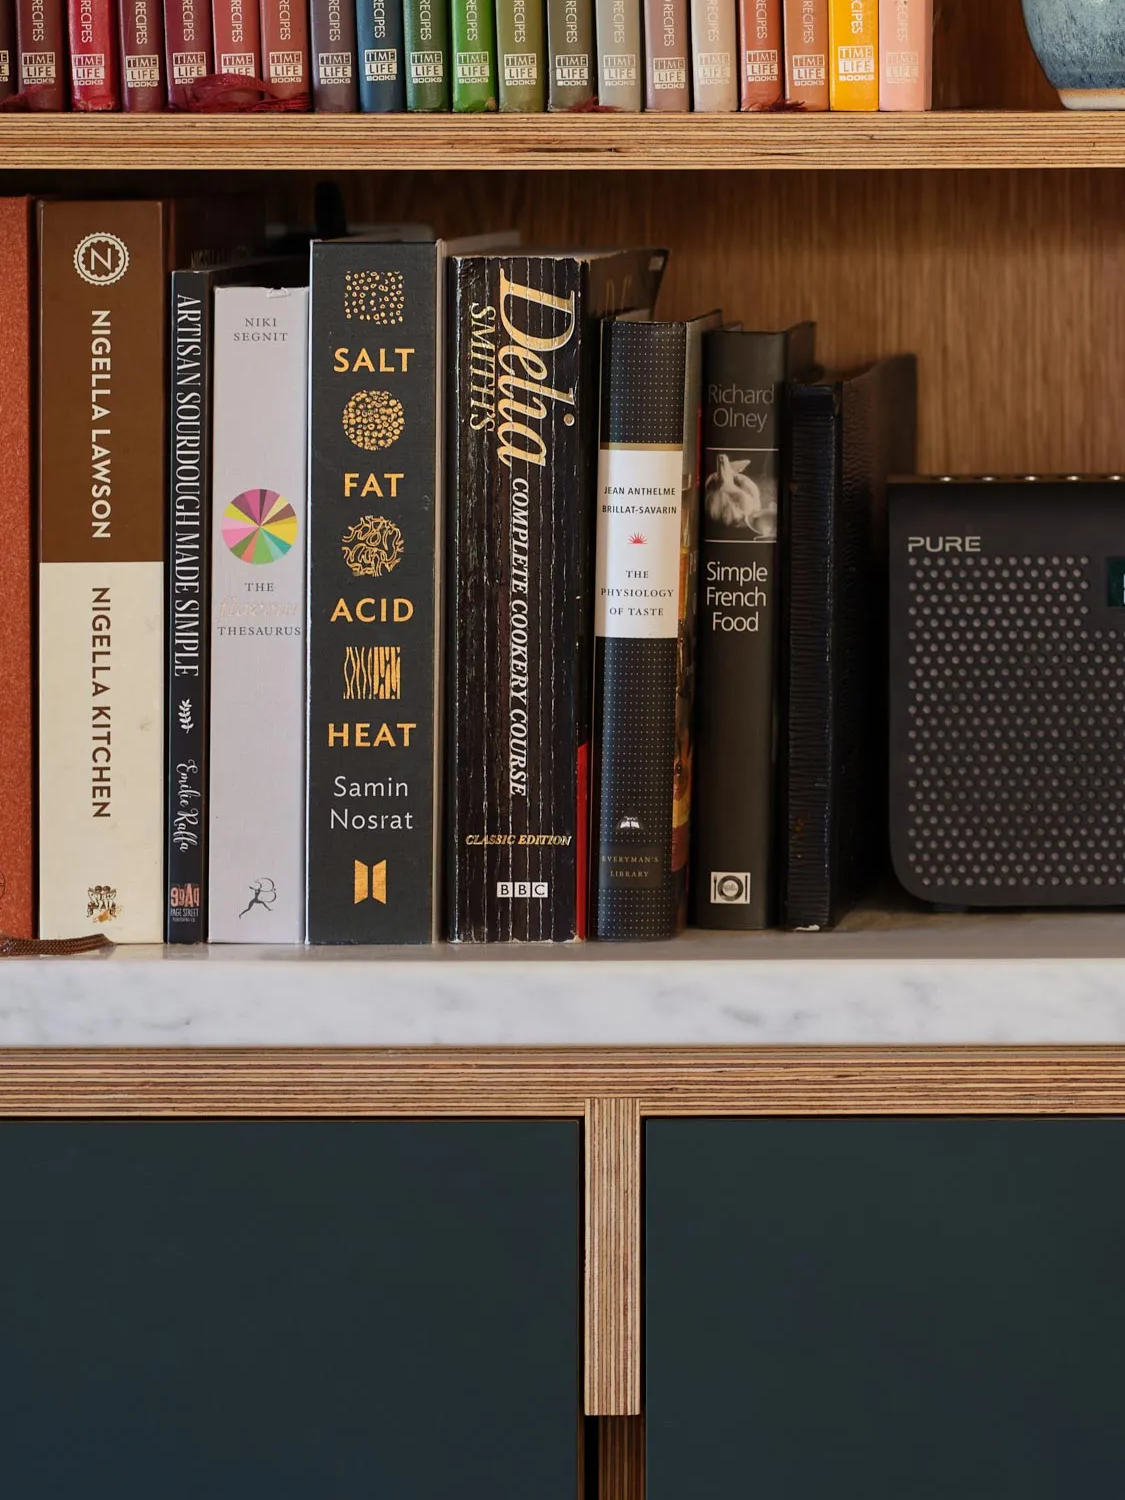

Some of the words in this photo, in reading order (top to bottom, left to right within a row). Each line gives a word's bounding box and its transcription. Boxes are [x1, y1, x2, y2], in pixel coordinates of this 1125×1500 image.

[80, 0, 92, 43] RECIPES
[134, 2, 146, 44] RECIPES
[230, 0, 243, 42] RECIPES
[513, 0, 525, 43] RECIPES
[565, 0, 577, 43] RECIPES
[73, 55, 103, 67] TIME
[127, 57, 158, 68] TIME
[366, 50, 396, 62] TIME
[75, 70, 100, 78] LIFE
[131, 70, 156, 80] LIFE
[369, 64, 394, 74] LIFE
[246, 318, 276, 327] NIKI
[177, 294, 201, 385] ARTISAN
[234, 333, 287, 341] SEGNIT
[92, 311, 111, 420] NIGELLA
[330, 347, 414, 372] SALT
[468, 302, 497, 433] SMITH'S
[498, 269, 575, 467] Delia
[708, 384, 775, 404] Richard
[713, 408, 767, 432] Olney
[176, 393, 200, 525] SOURDOUGH
[92, 430, 111, 537] LAWSON
[345, 473, 404, 497] FAT
[604, 486, 624, 495] JEAN
[602, 504, 677, 514] BRILLAT-SAVARIN
[511, 477, 529, 594] COMPLETE
[908, 536, 980, 552] PURE
[175, 532, 200, 593] MADE
[707, 561, 768, 586] Simple
[245, 583, 273, 591] THE
[601, 587, 674, 597] PHYSIOLOGY
[706, 587, 766, 606] French
[330, 598, 413, 622] ACID
[628, 608, 663, 616] TASTE
[713, 612, 758, 631] Food
[92, 588, 110, 697] NIGELLA
[175, 600, 199, 676] SIMPLE
[217, 627, 300, 635] THESAURUS
[510, 599, 529, 702] COOKERY
[329, 723, 416, 746] HEAT
[92, 706, 111, 817] KITCHEN
[510, 708, 527, 796] COURSE
[177, 760, 200, 807] Emilie
[334, 776, 407, 797] Samin
[331, 809, 413, 829] Nosrat
[173, 810, 198, 852] Raffa
[465, 835, 515, 846] CLASSIC
[517, 835, 571, 847] EDITION
[601, 855, 659, 863] EVERYMAN'S
[610, 870, 649, 878] LIBRARY
[498, 883, 547, 896] BBC
